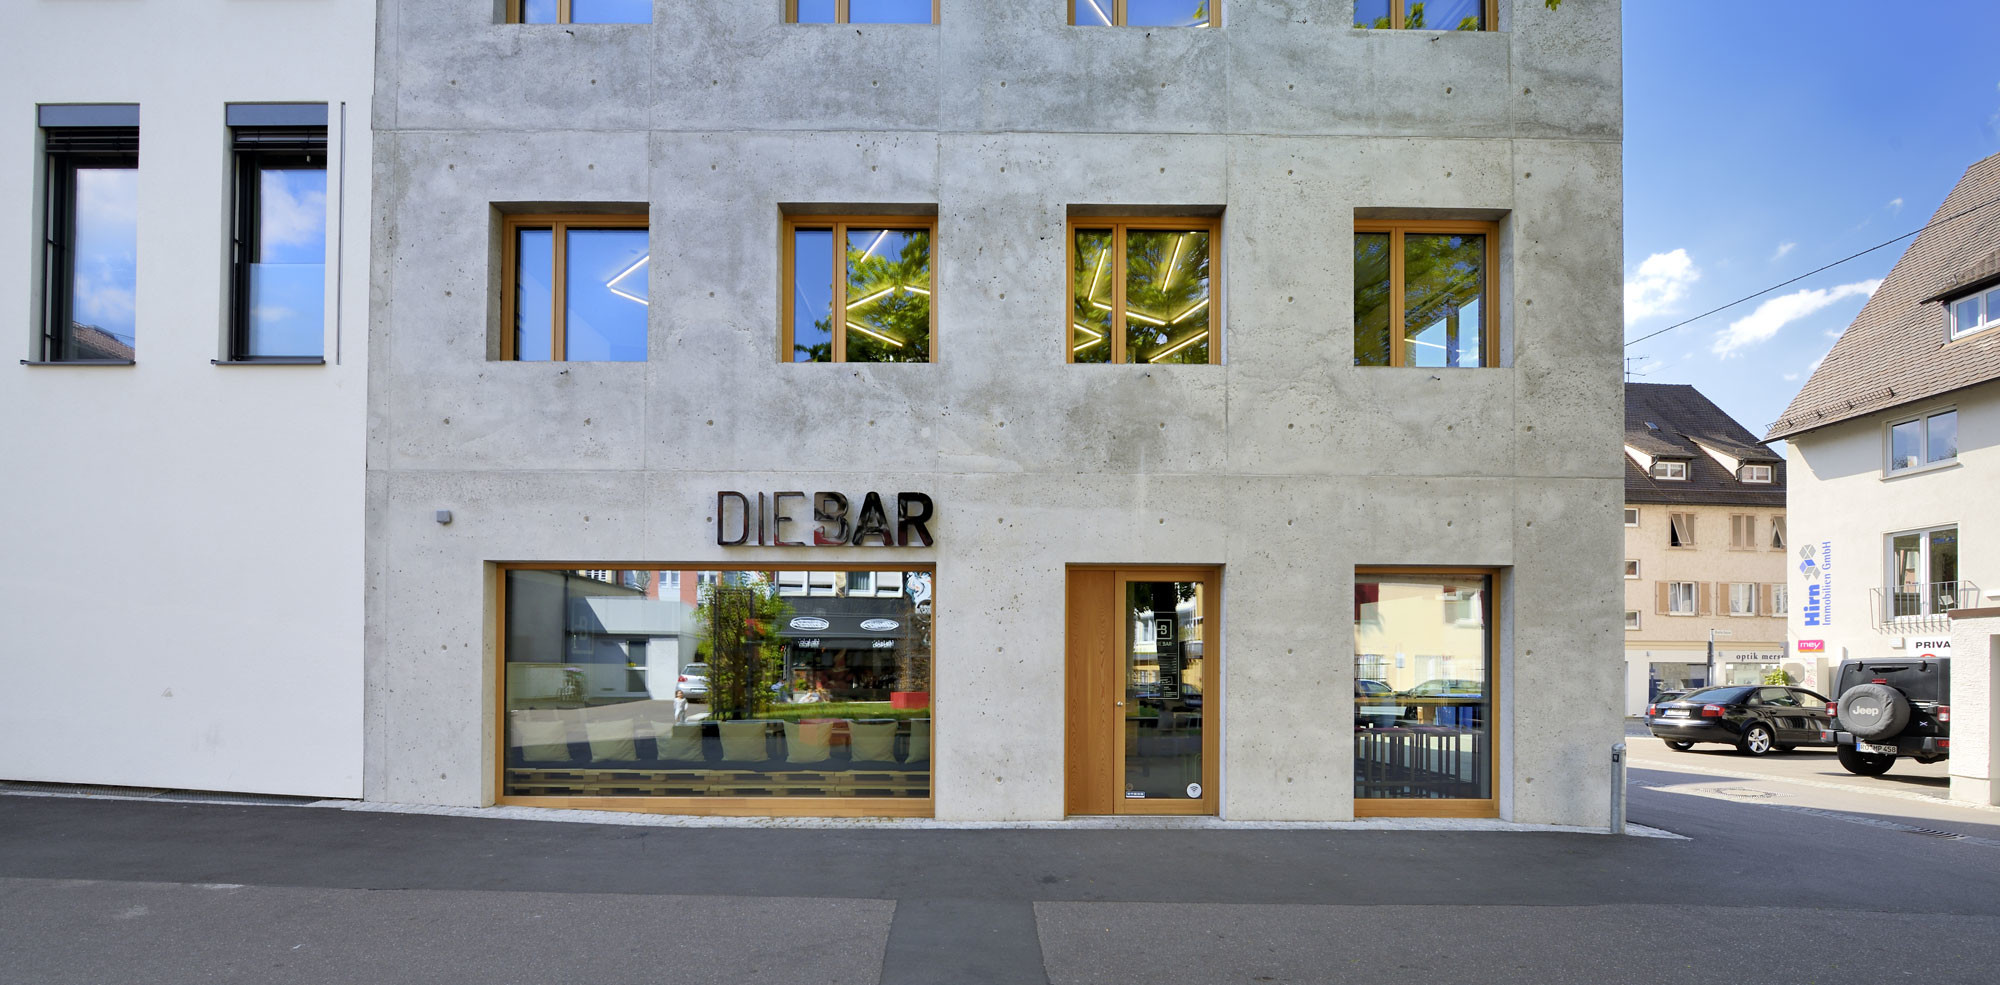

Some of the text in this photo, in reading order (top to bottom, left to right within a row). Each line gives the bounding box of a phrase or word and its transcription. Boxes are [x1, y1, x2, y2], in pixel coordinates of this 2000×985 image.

[1822, 541, 1832, 626] Immobilien GmbH
[1803, 584, 1820, 626] Hirn
[1800, 642, 1821, 650] mey
[1915, 641, 1951, 649] PRIVA
[1736, 652, 1758, 662] optik
[1852, 705, 1879, 716] Jeep
